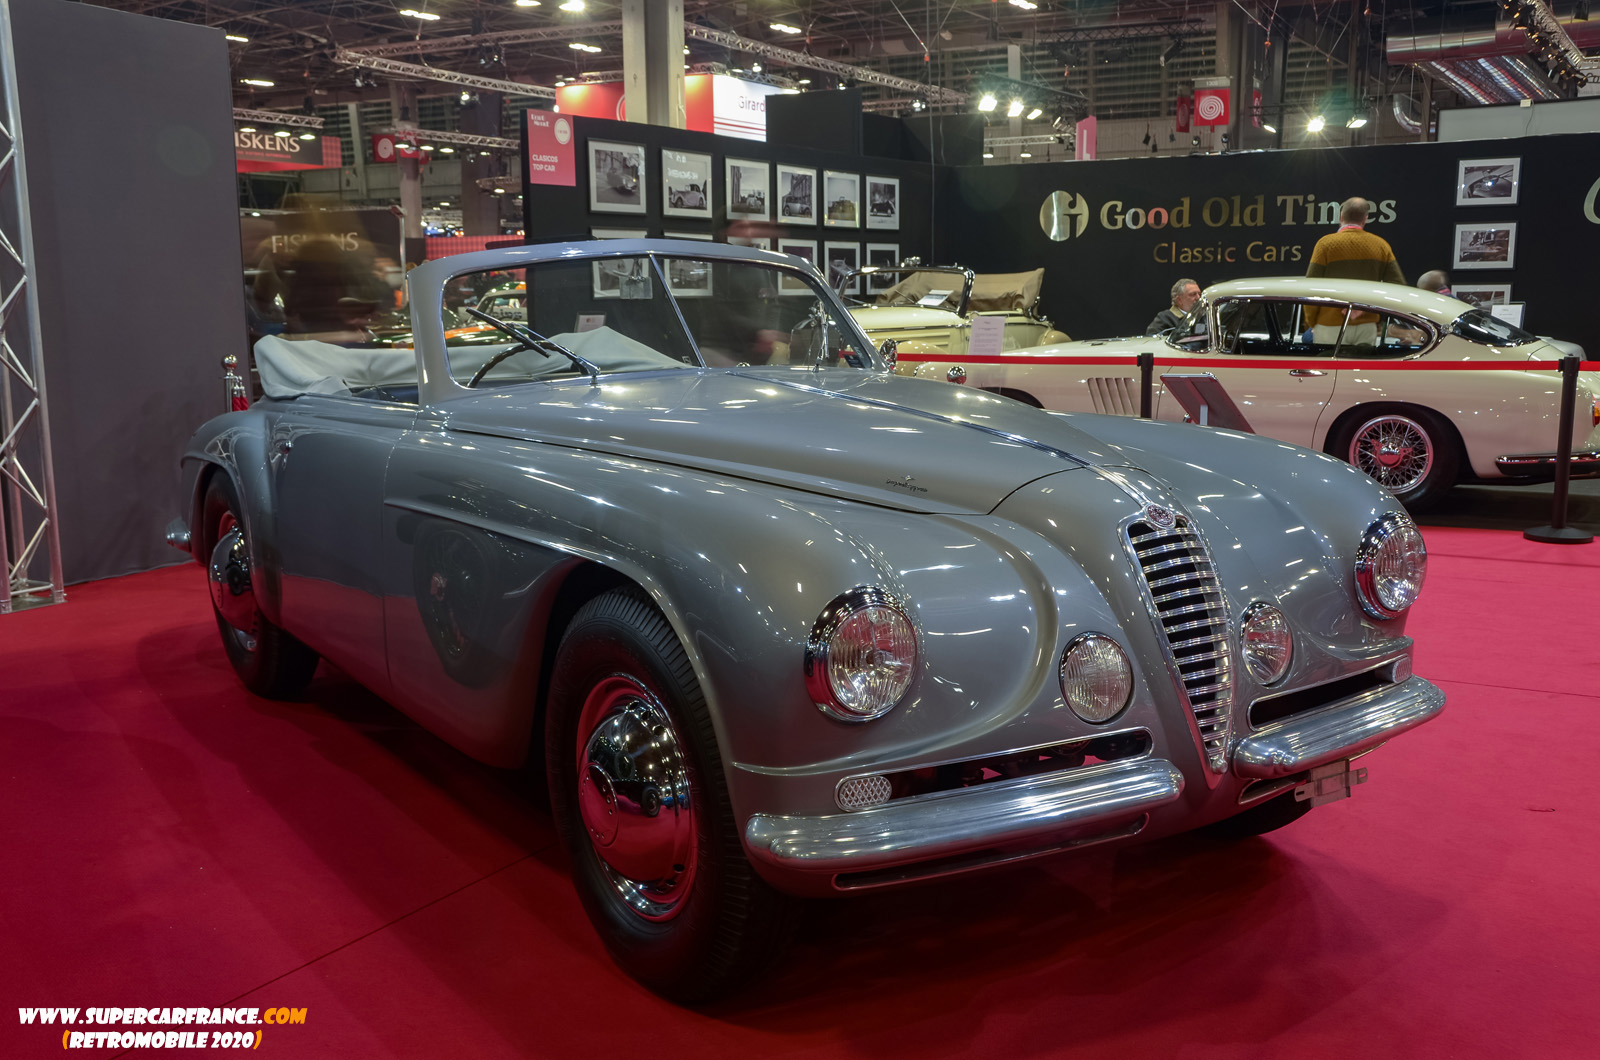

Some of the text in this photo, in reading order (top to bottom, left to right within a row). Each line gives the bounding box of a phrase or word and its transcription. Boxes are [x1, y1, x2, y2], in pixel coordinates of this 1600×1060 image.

[532, 154, 559, 163] CLASICOS
[532, 163, 556, 172] TOP CAR
[1100, 196, 1191, 230] Good
[1202, 194, 1266, 228] Old
[271, 231, 359, 254] FISNS
[1153, 240, 1302, 263] Classic Cars
